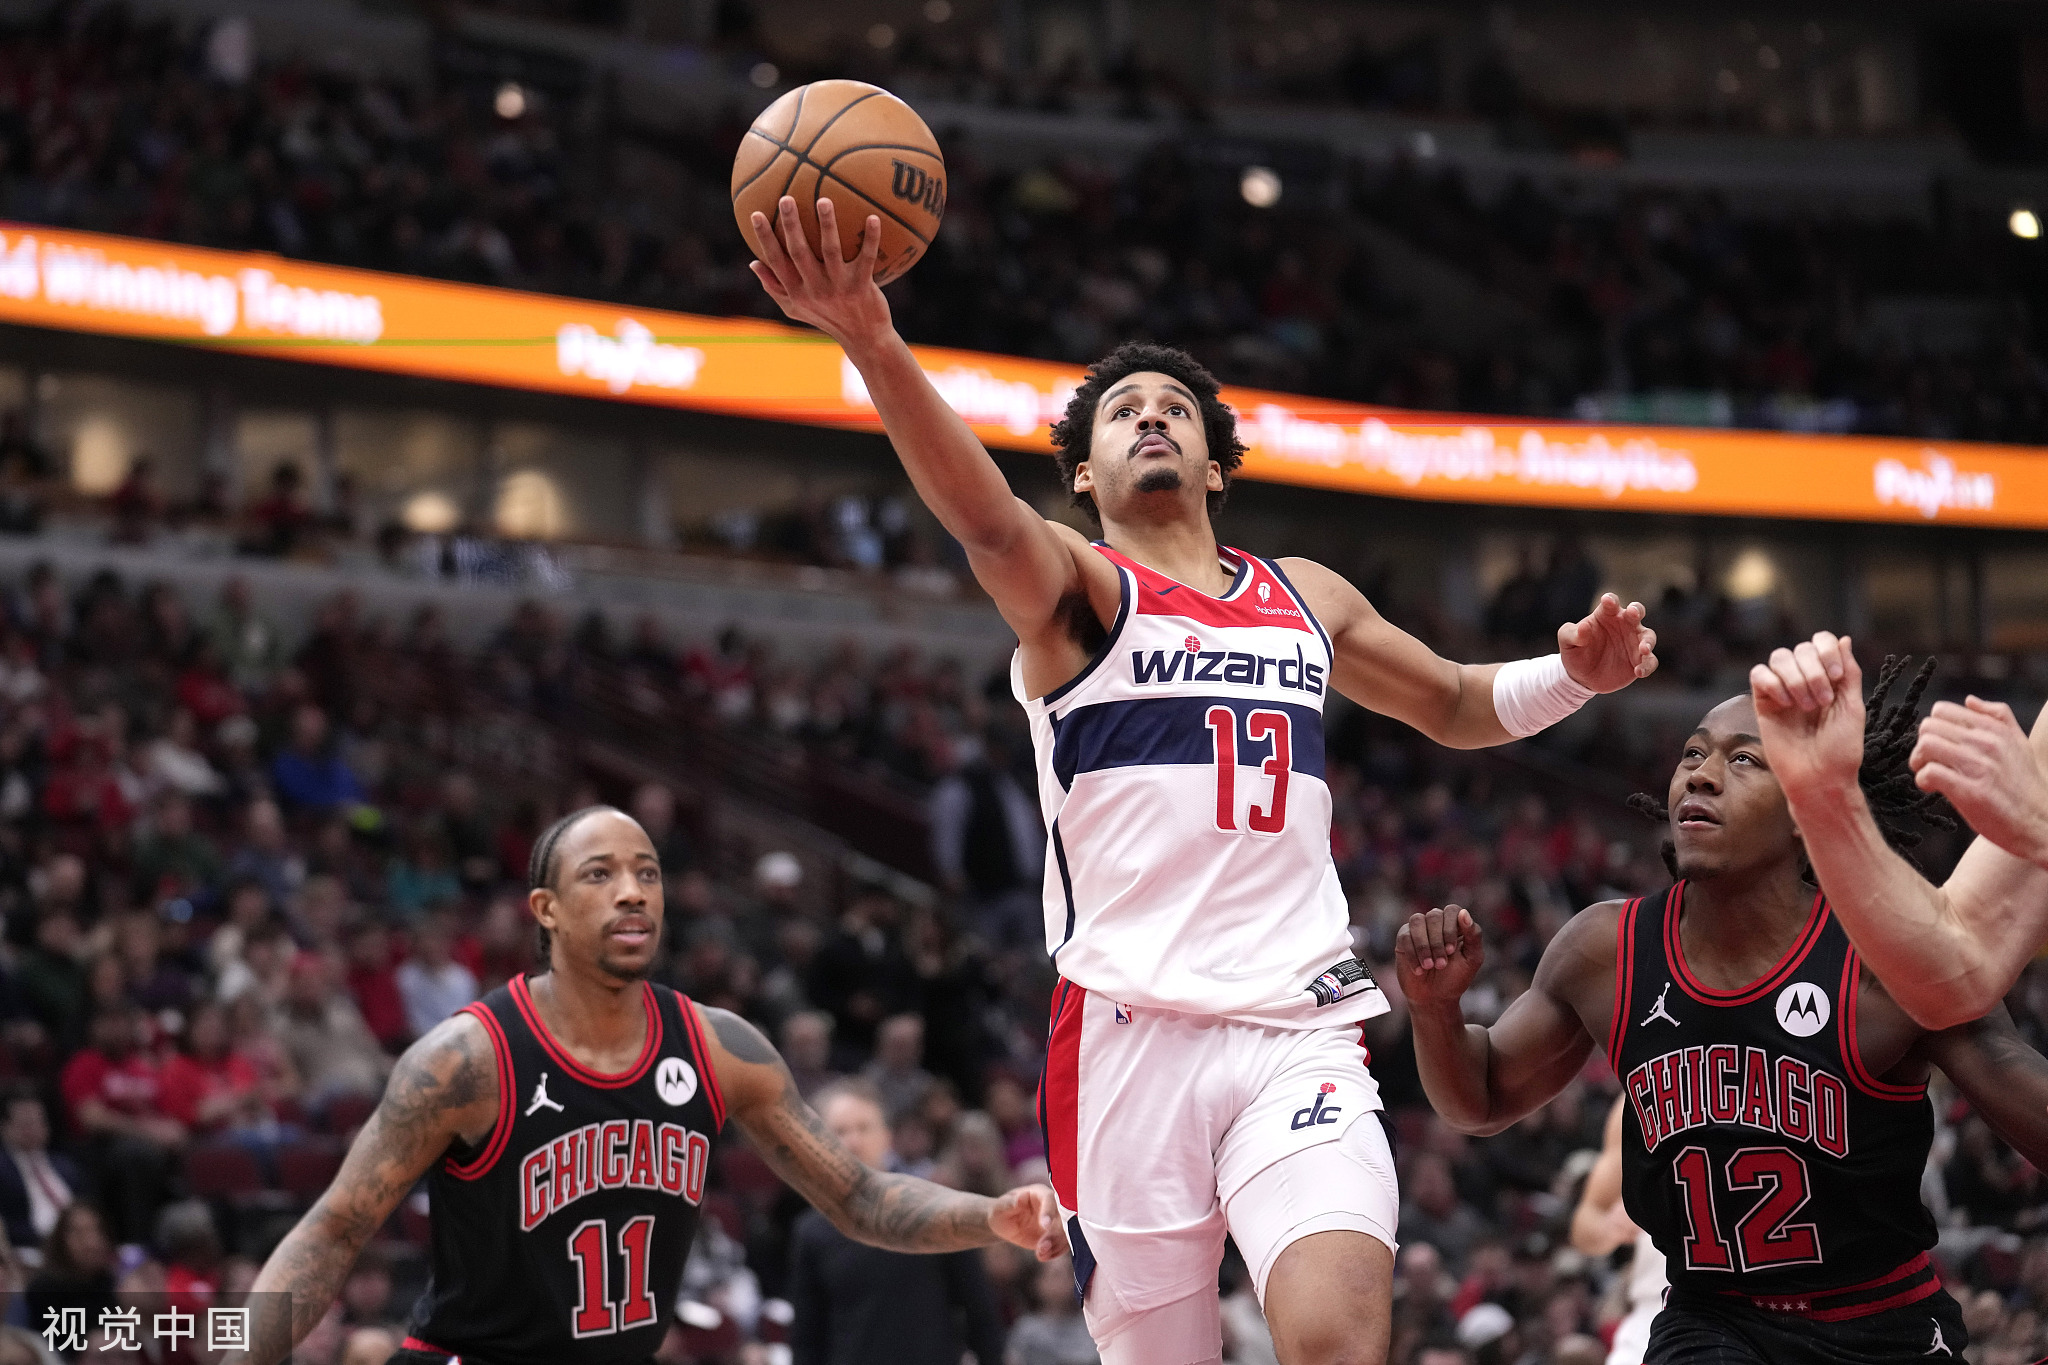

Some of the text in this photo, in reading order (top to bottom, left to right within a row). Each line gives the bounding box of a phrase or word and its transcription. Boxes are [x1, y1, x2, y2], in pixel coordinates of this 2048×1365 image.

[1254, 604, 1301, 618] Robinhood
[1205, 704, 1293, 837] 13
[1627, 1044, 1849, 1159] CHICAGO
[520, 1119, 710, 1232] CHICAGO
[1673, 1146, 1823, 1273] 12
[567, 1215, 658, 1339] 11
